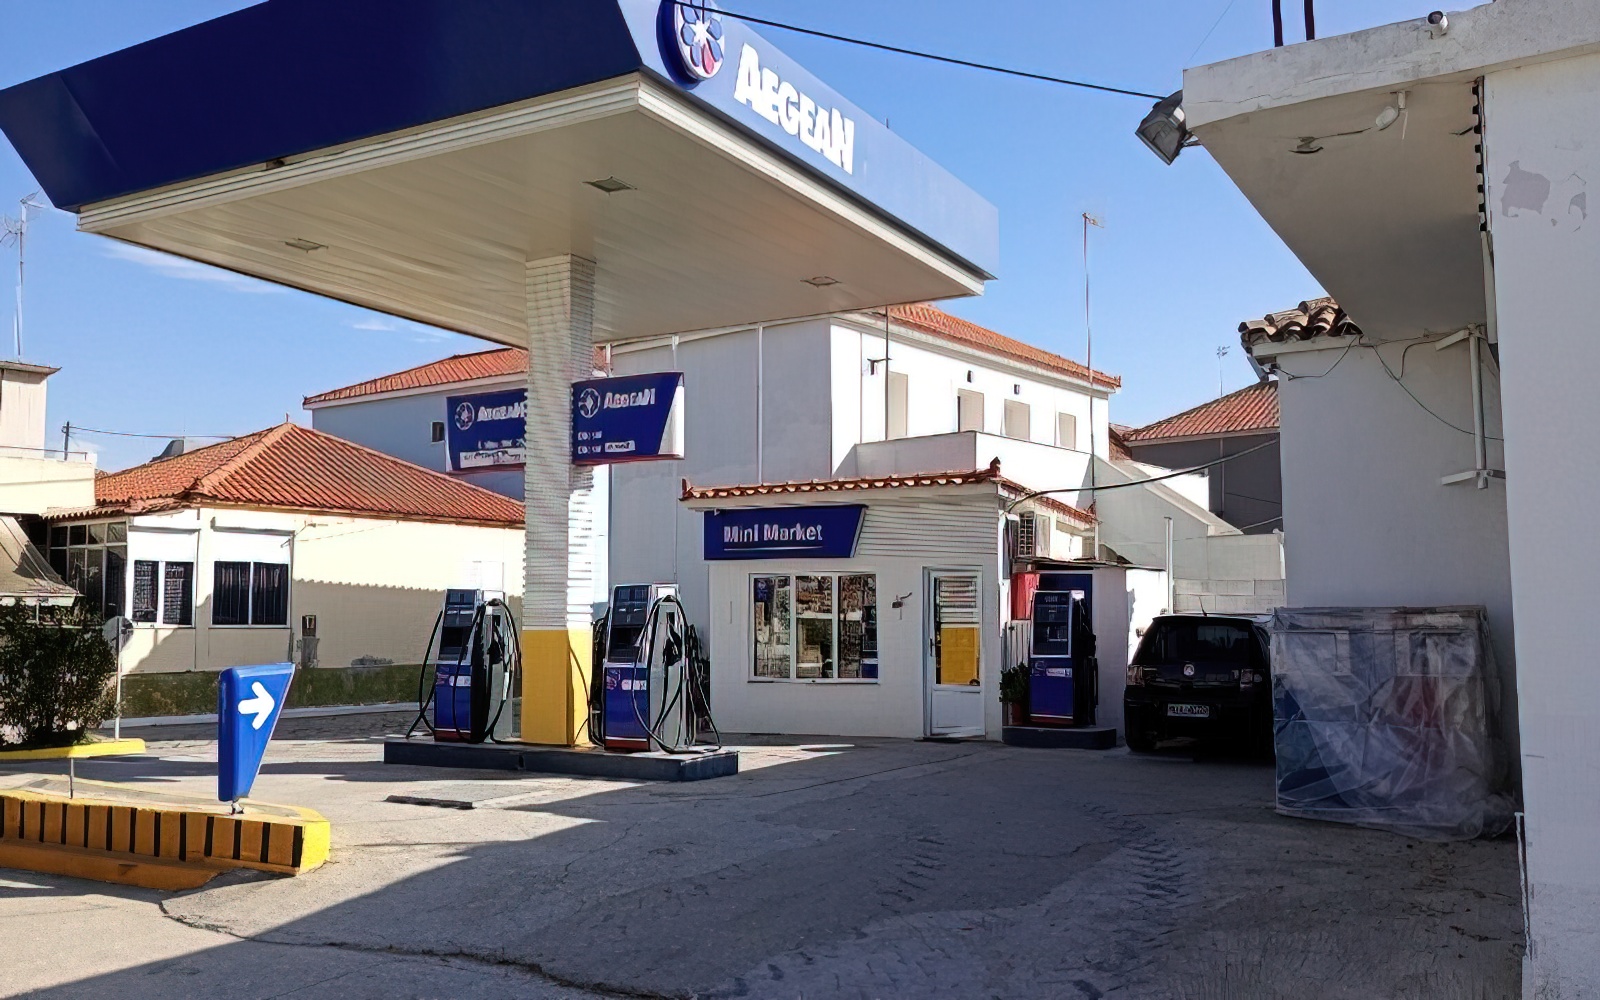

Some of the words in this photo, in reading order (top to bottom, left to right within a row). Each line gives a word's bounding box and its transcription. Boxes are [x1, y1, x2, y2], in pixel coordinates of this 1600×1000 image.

[734, 42, 855, 175] AEGEAN
[603, 388, 655, 409] AEGEAN
[724, 524, 758, 543] Mini
[763, 522, 823, 542] Market
